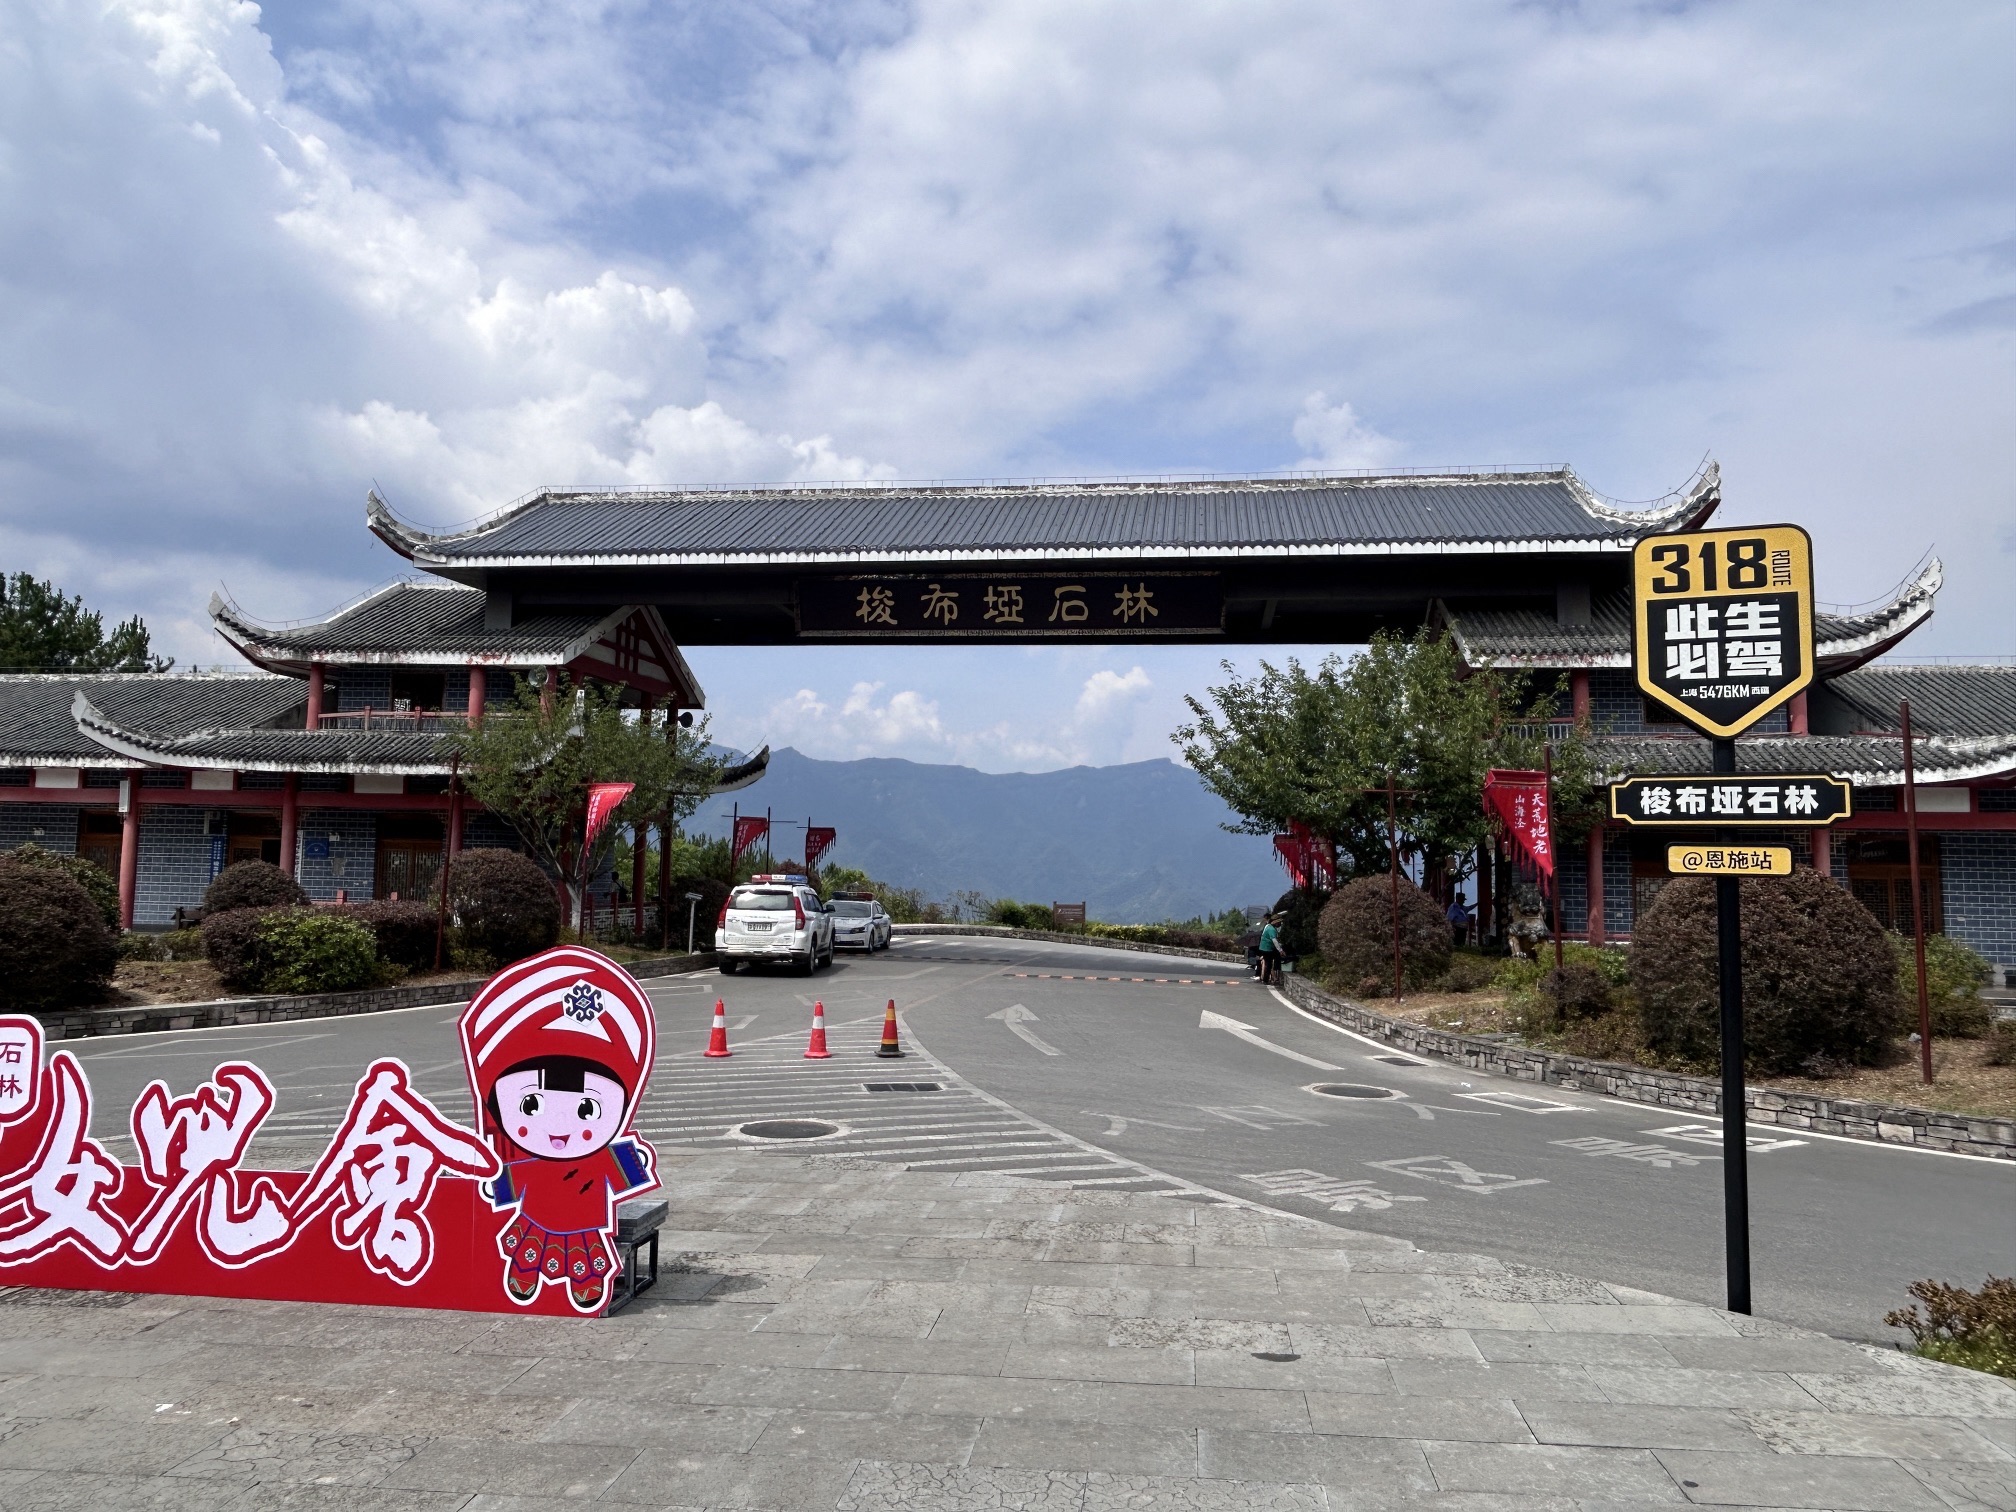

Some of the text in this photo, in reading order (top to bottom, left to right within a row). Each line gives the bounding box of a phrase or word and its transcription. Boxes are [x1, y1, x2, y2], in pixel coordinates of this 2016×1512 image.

[1651, 538, 1767, 594] 318
[1771, 549, 1791, 587] ROUTE
[1664, 601, 1781, 641] 此生
[1664, 641, 1783, 679] 必驾
[1699, 684, 1750, 699] 5476KM
[1640, 785, 1819, 815] 梭布垭石林
[1530, 793, 1548, 854] 天荒地老
[1682, 850, 1772, 870] @恩施站
